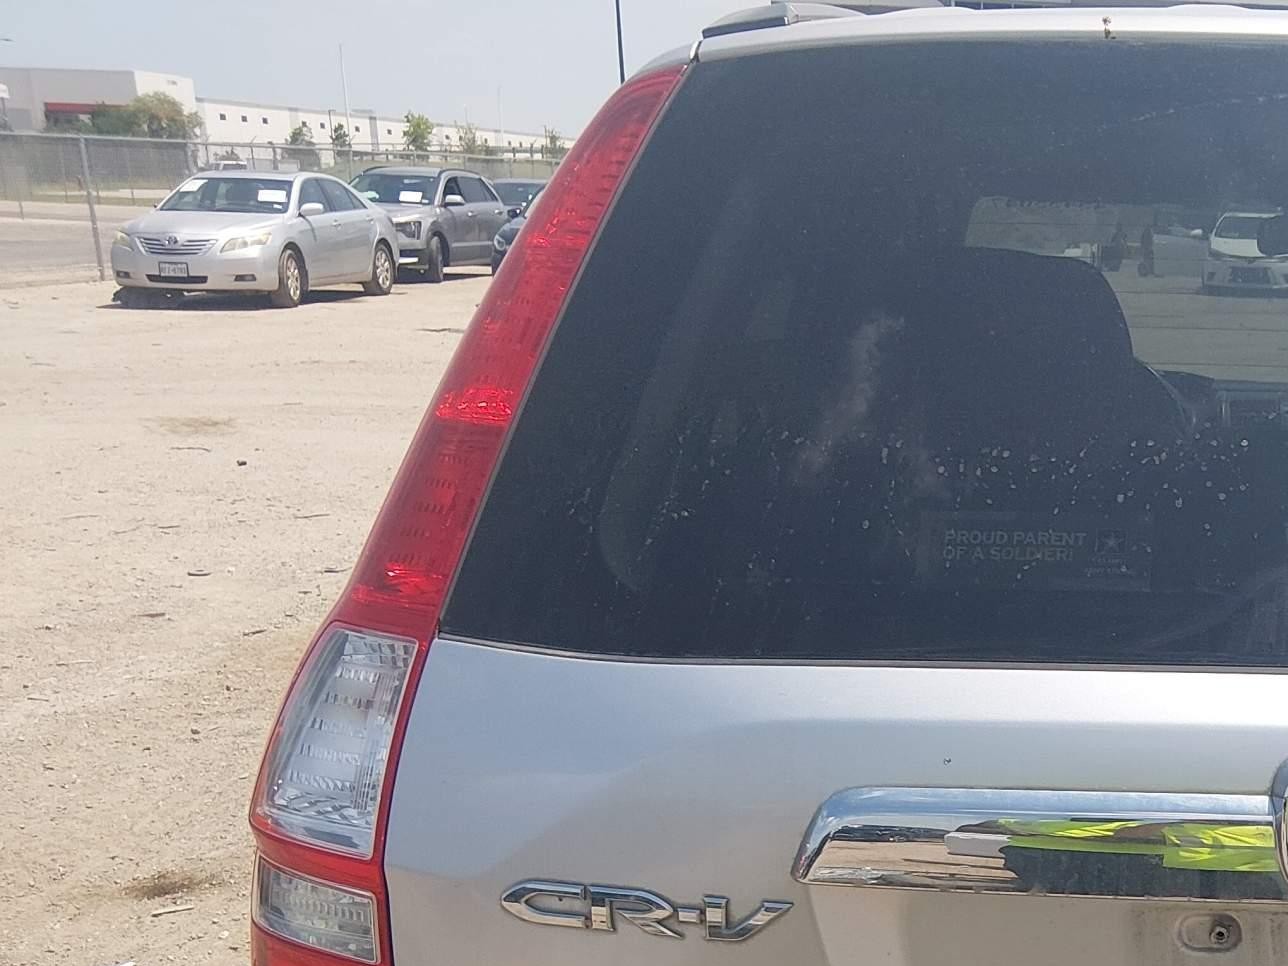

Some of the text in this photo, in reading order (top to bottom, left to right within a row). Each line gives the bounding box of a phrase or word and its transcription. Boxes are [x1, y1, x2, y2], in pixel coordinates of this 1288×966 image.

[944, 529, 1087, 545] PROUD PARENT
[943, 545, 968, 560] OF
[971, 546, 985, 560] A
[501, 878, 795, 942] CR-V
